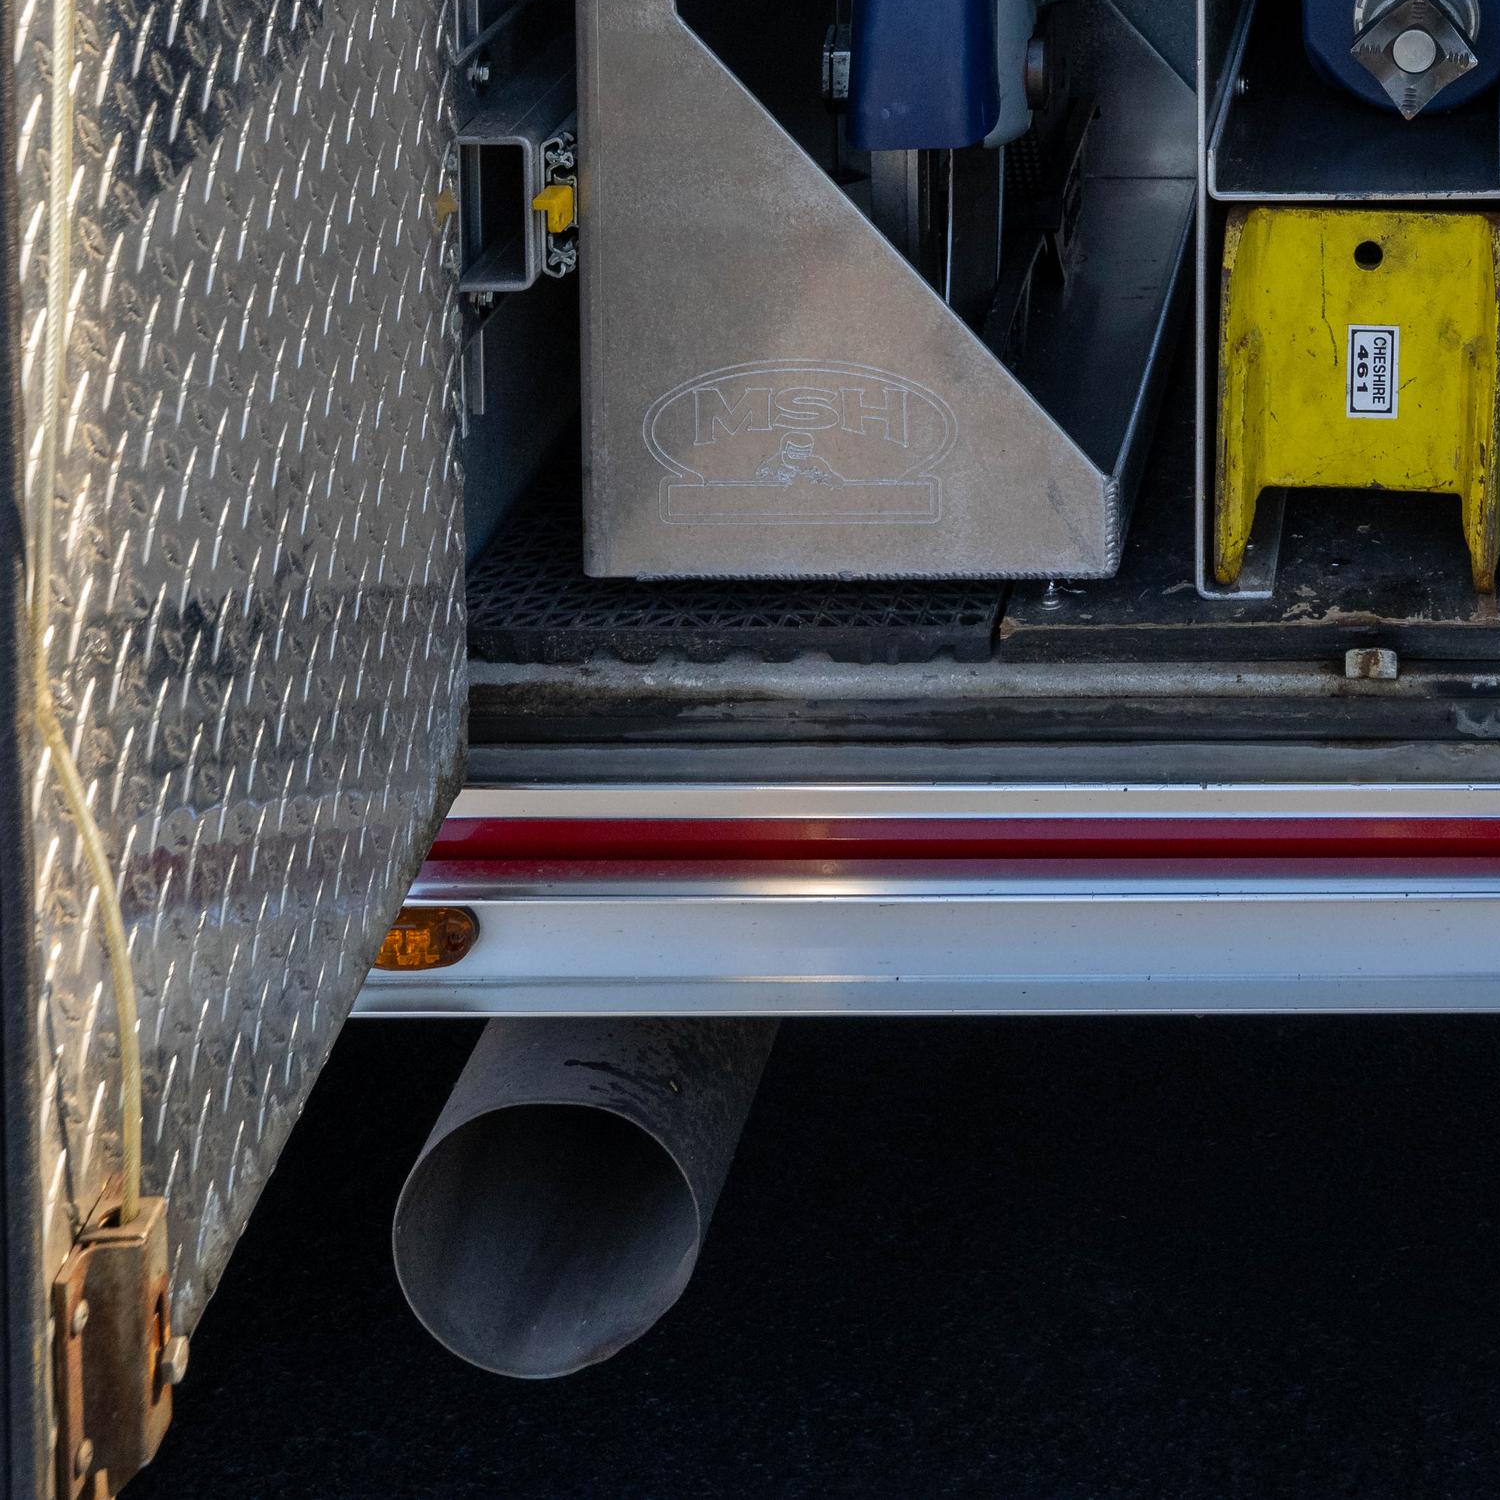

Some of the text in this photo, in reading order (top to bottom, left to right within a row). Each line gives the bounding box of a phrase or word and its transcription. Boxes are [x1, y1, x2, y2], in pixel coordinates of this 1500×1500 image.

[1356, 344, 1369, 393] 461
[1372, 336, 1387, 405] CHESHIRE
[692, 386, 910, 449] MSH
